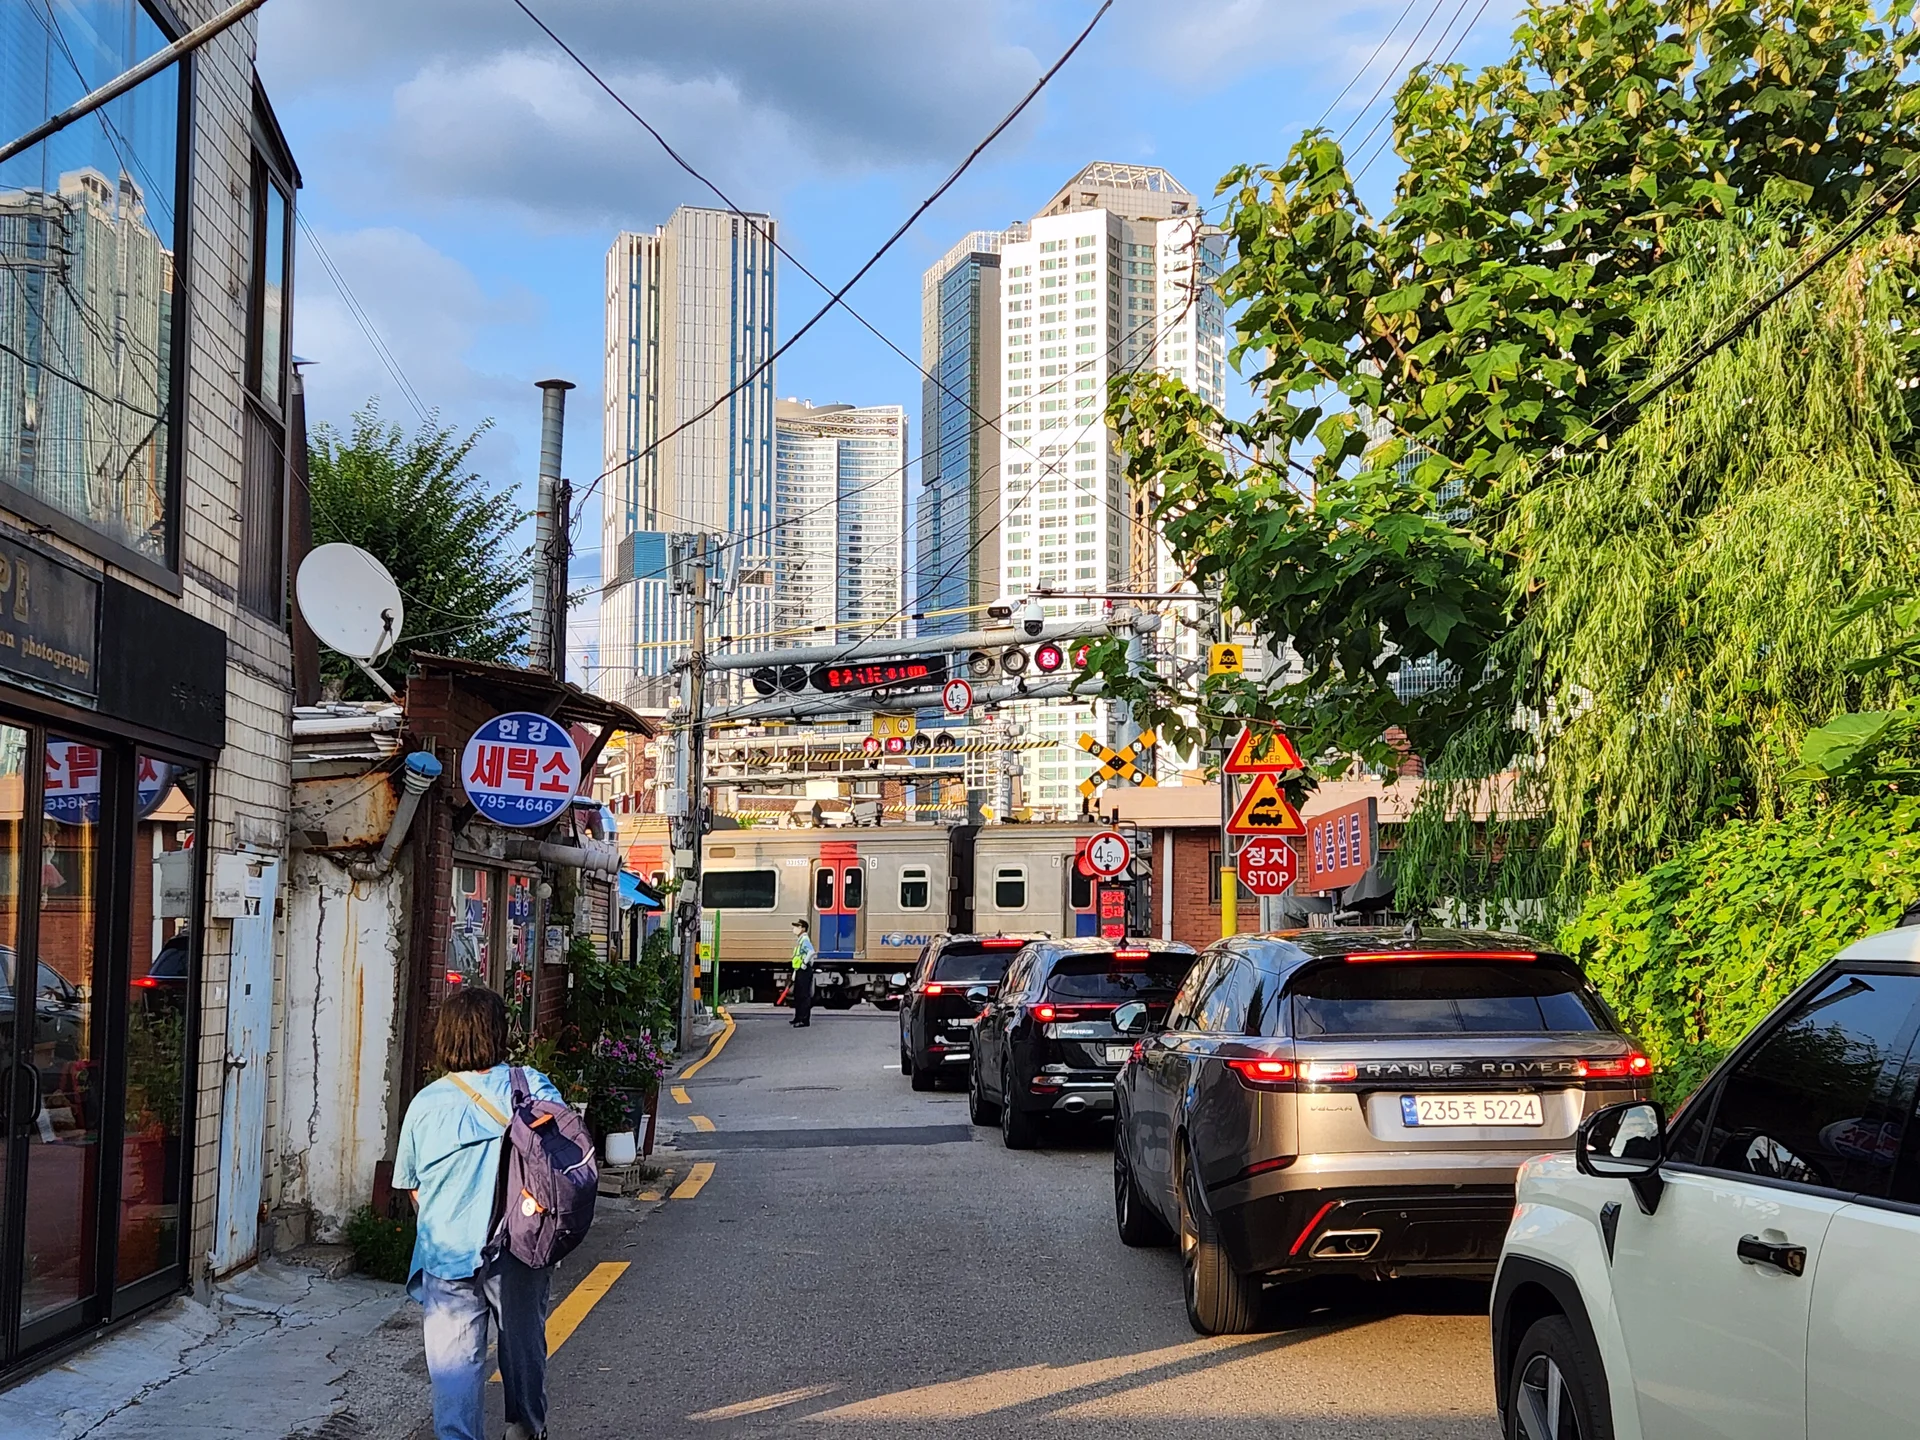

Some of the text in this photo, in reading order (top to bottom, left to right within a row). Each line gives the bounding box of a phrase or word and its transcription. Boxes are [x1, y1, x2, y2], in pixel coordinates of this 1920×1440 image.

[21, 635, 90, 679] photography
[1221, 655, 1236, 663] SOS
[1243, 754, 1281, 764] DGER
[469, 745, 571, 793] 세탁소
[479, 794, 554, 813] 795-4646
[1094, 845, 1122, 863] 4.5m
[1246, 846, 1288, 867] 정지
[1247, 870, 1289, 887] STOP
[1367, 1062, 1572, 1076] RANGE ROVER
[1420, 1100, 1477, 1121] 235주
[1483, 1099, 1536, 1120] 5224
